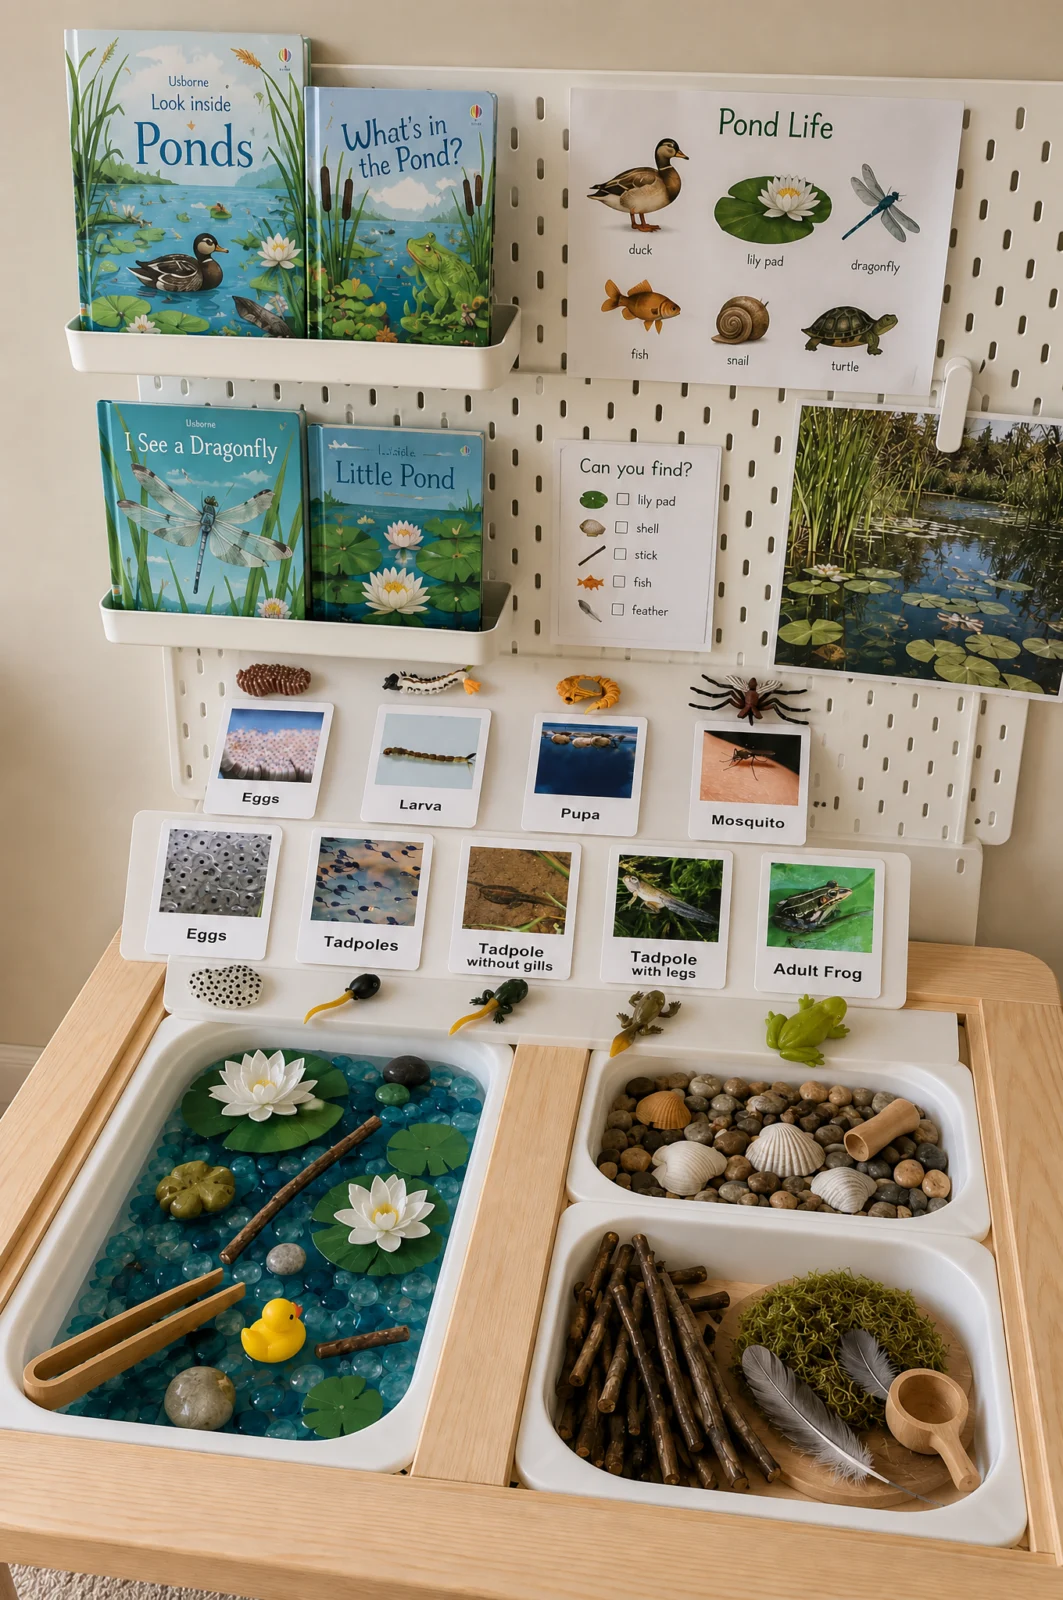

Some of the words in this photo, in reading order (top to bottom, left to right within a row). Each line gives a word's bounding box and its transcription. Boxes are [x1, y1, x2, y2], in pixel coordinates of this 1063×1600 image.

[169, 76, 208, 87] Usborne
[152, 94, 185, 110] Look
[191, 94, 231, 111] inside
[720, 108, 779, 137] Pond
[789, 112, 832, 139] Life
[341, 116, 422, 152] What's
[428, 116, 447, 138] in
[134, 121, 253, 168] Ponds
[359, 152, 391, 178] the
[397, 138, 463, 174] Pond?
[629, 244, 652, 255] duck
[748, 254, 761, 268] lily
[765, 256, 783, 269] pad
[851, 260, 900, 275] dragonfly
[631, 348, 648, 359] fish
[727, 355, 749, 365] snail
[832, 361, 859, 372] turtle
[186, 419, 215, 428] Usborne
[125, 432, 132, 452] I
[139, 434, 168, 453] See
[175, 442, 184, 453] a
[190, 436, 277, 464] Dragonfly
[336, 461, 392, 486] Little
[401, 464, 454, 489] Pond
[580, 458, 609, 474] Can
[617, 465, 644, 479] you
[652, 460, 692, 476] find?
[638, 494, 652, 508] lily
[656, 496, 675, 508] pad
[637, 523, 659, 533] shell
[635, 551, 657, 560] stick
[634, 577, 651, 587] fish
[632, 605, 668, 616] feather
[242, 793, 279, 805] Eggs
[400, 800, 441, 811] Larva
[561, 808, 599, 821] Pupa
[712, 815, 784, 829] Mosquito
[187, 928, 226, 943] Eggs
[324, 936, 398, 951] Tadpoles
[479, 943, 544, 959] Tadpole
[467, 957, 519, 970] without
[524, 959, 553, 972] gills
[631, 951, 697, 966] Tadpole
[632, 965, 661, 978] with
[666, 967, 697, 981] legs
[774, 963, 818, 976] Adult
[825, 966, 861, 982] Frog
